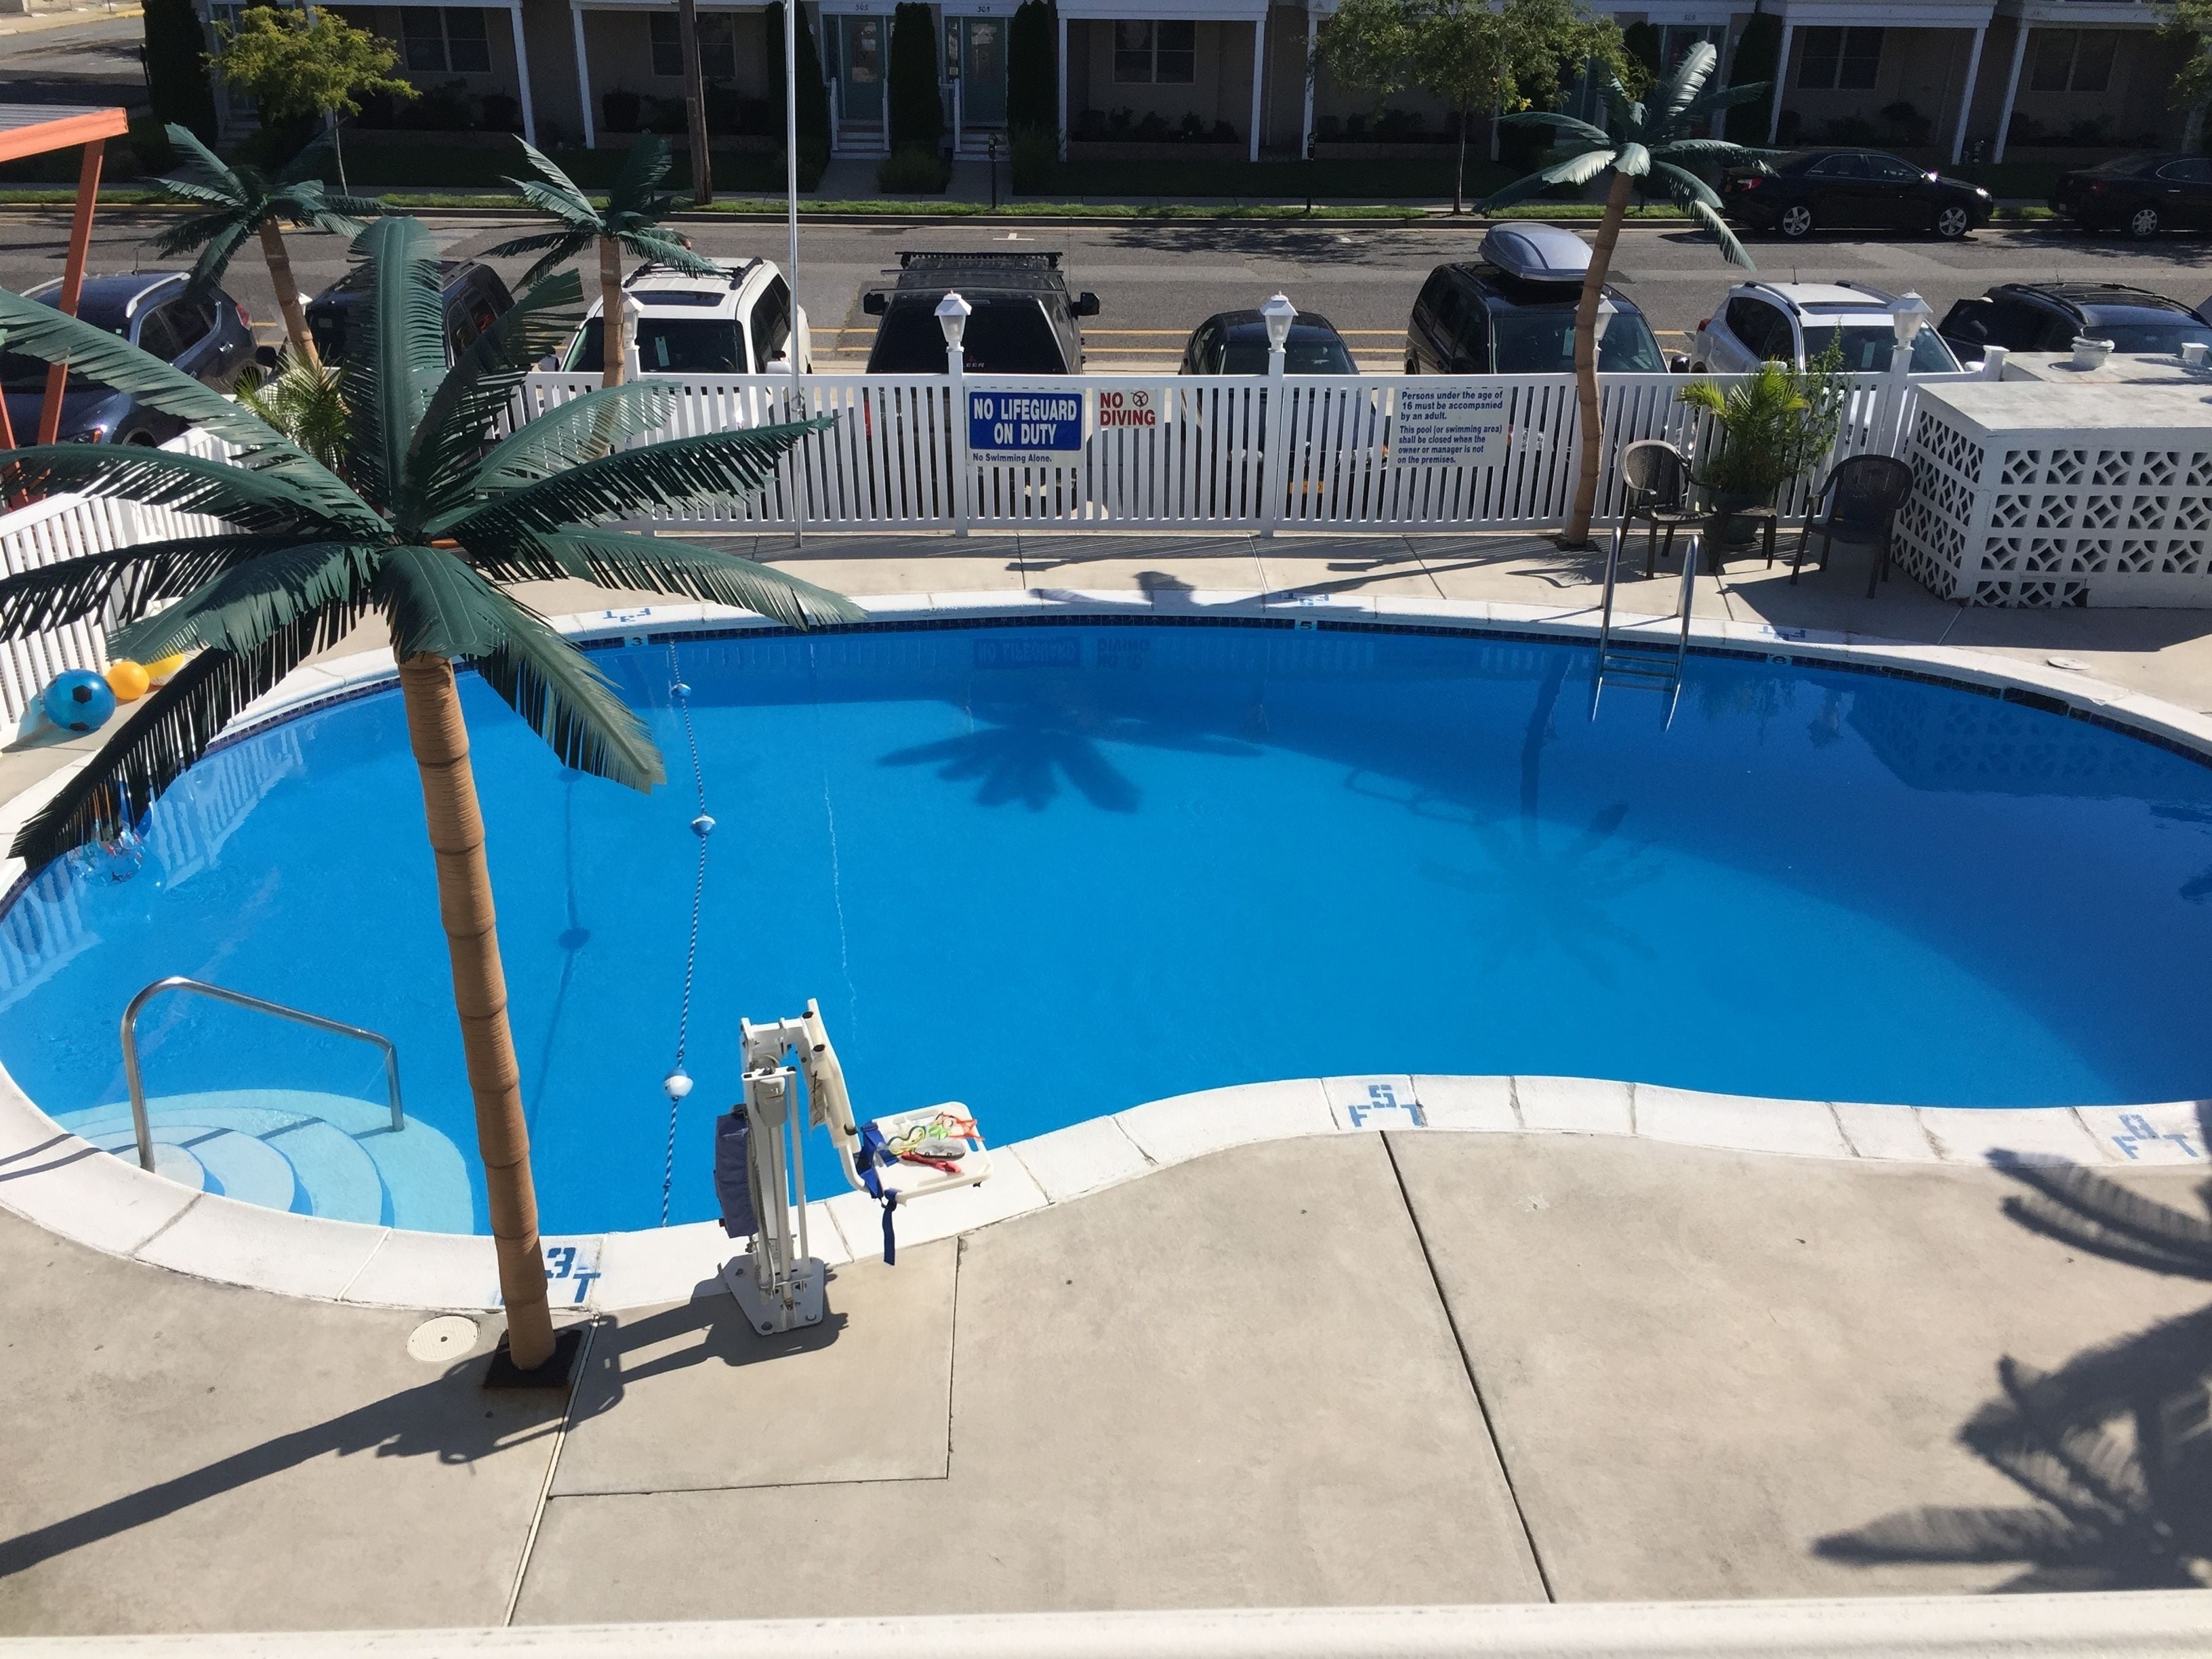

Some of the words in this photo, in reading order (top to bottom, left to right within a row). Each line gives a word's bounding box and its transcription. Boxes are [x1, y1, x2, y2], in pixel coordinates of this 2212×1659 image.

[1100, 392, 1123, 408] NO
[1402, 392, 1434, 400] Persons
[974, 398, 994, 419] NO
[1001, 399, 1077, 420] LIFEGUARD
[1449, 401, 1503, 411] accompanied
[1100, 409, 1155, 426] DIVING
[1401, 412, 1410, 422] by
[1425, 412, 1448, 420] adult.
[994, 423, 1013, 445] ON
[1021, 424, 1057, 445] DUTY
[1400, 426, 1414, 434] This
[1416, 426, 1431, 435] pool
[1434, 425, 1443, 435] (or
[1445, 424, 1481, 434] swimming
[1483, 425, 1502, 434] area)
[1429, 435, 1452, 443] closed
[1431, 447, 1462, 455] manager
[1464, 445, 1471, 453] is
[985, 453, 1026, 464] Swimming
[1028, 453, 1052, 462] Alone.
[1421, 455, 1456, 465] premises.
[1300, 621, 1312, 630] 5
[631, 637, 643, 646] 3
[1368, 1084, 1397, 1107] 5
[546, 1247, 576, 1278] 3
